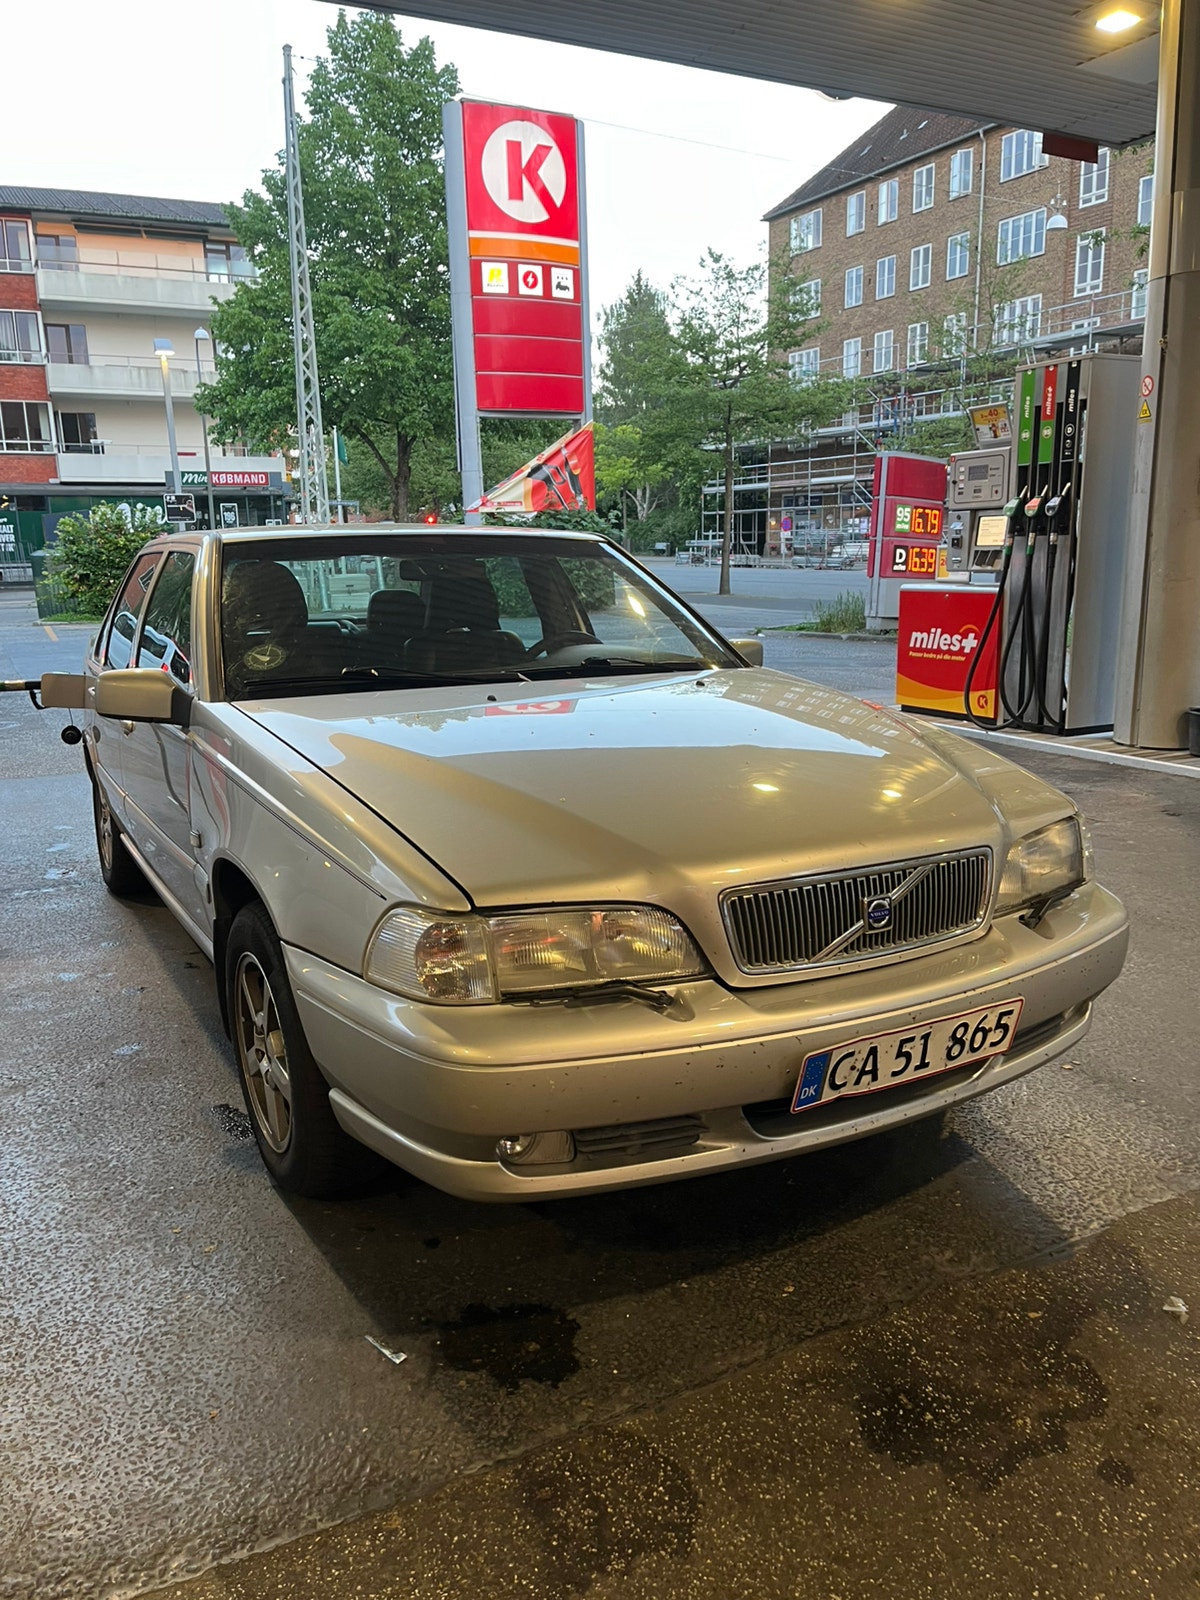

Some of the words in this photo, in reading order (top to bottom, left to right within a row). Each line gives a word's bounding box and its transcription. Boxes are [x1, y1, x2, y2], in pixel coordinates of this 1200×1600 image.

[1067, 389, 1076, 412] miles
[182, 472, 208, 484] Min
[212, 473, 266, 484] KØBMAND
[896, 507, 911, 522] 95
[895, 548, 906, 563] D
[909, 627, 978, 654] miles+
[977, 695, 988, 709] K
[870, 910, 889, 918] VOLVO
[828, 1045, 879, 1092] CA
[890, 1031, 933, 1078] 51
[945, 1008, 1015, 1062] 865
[801, 1085, 817, 1100] DK
